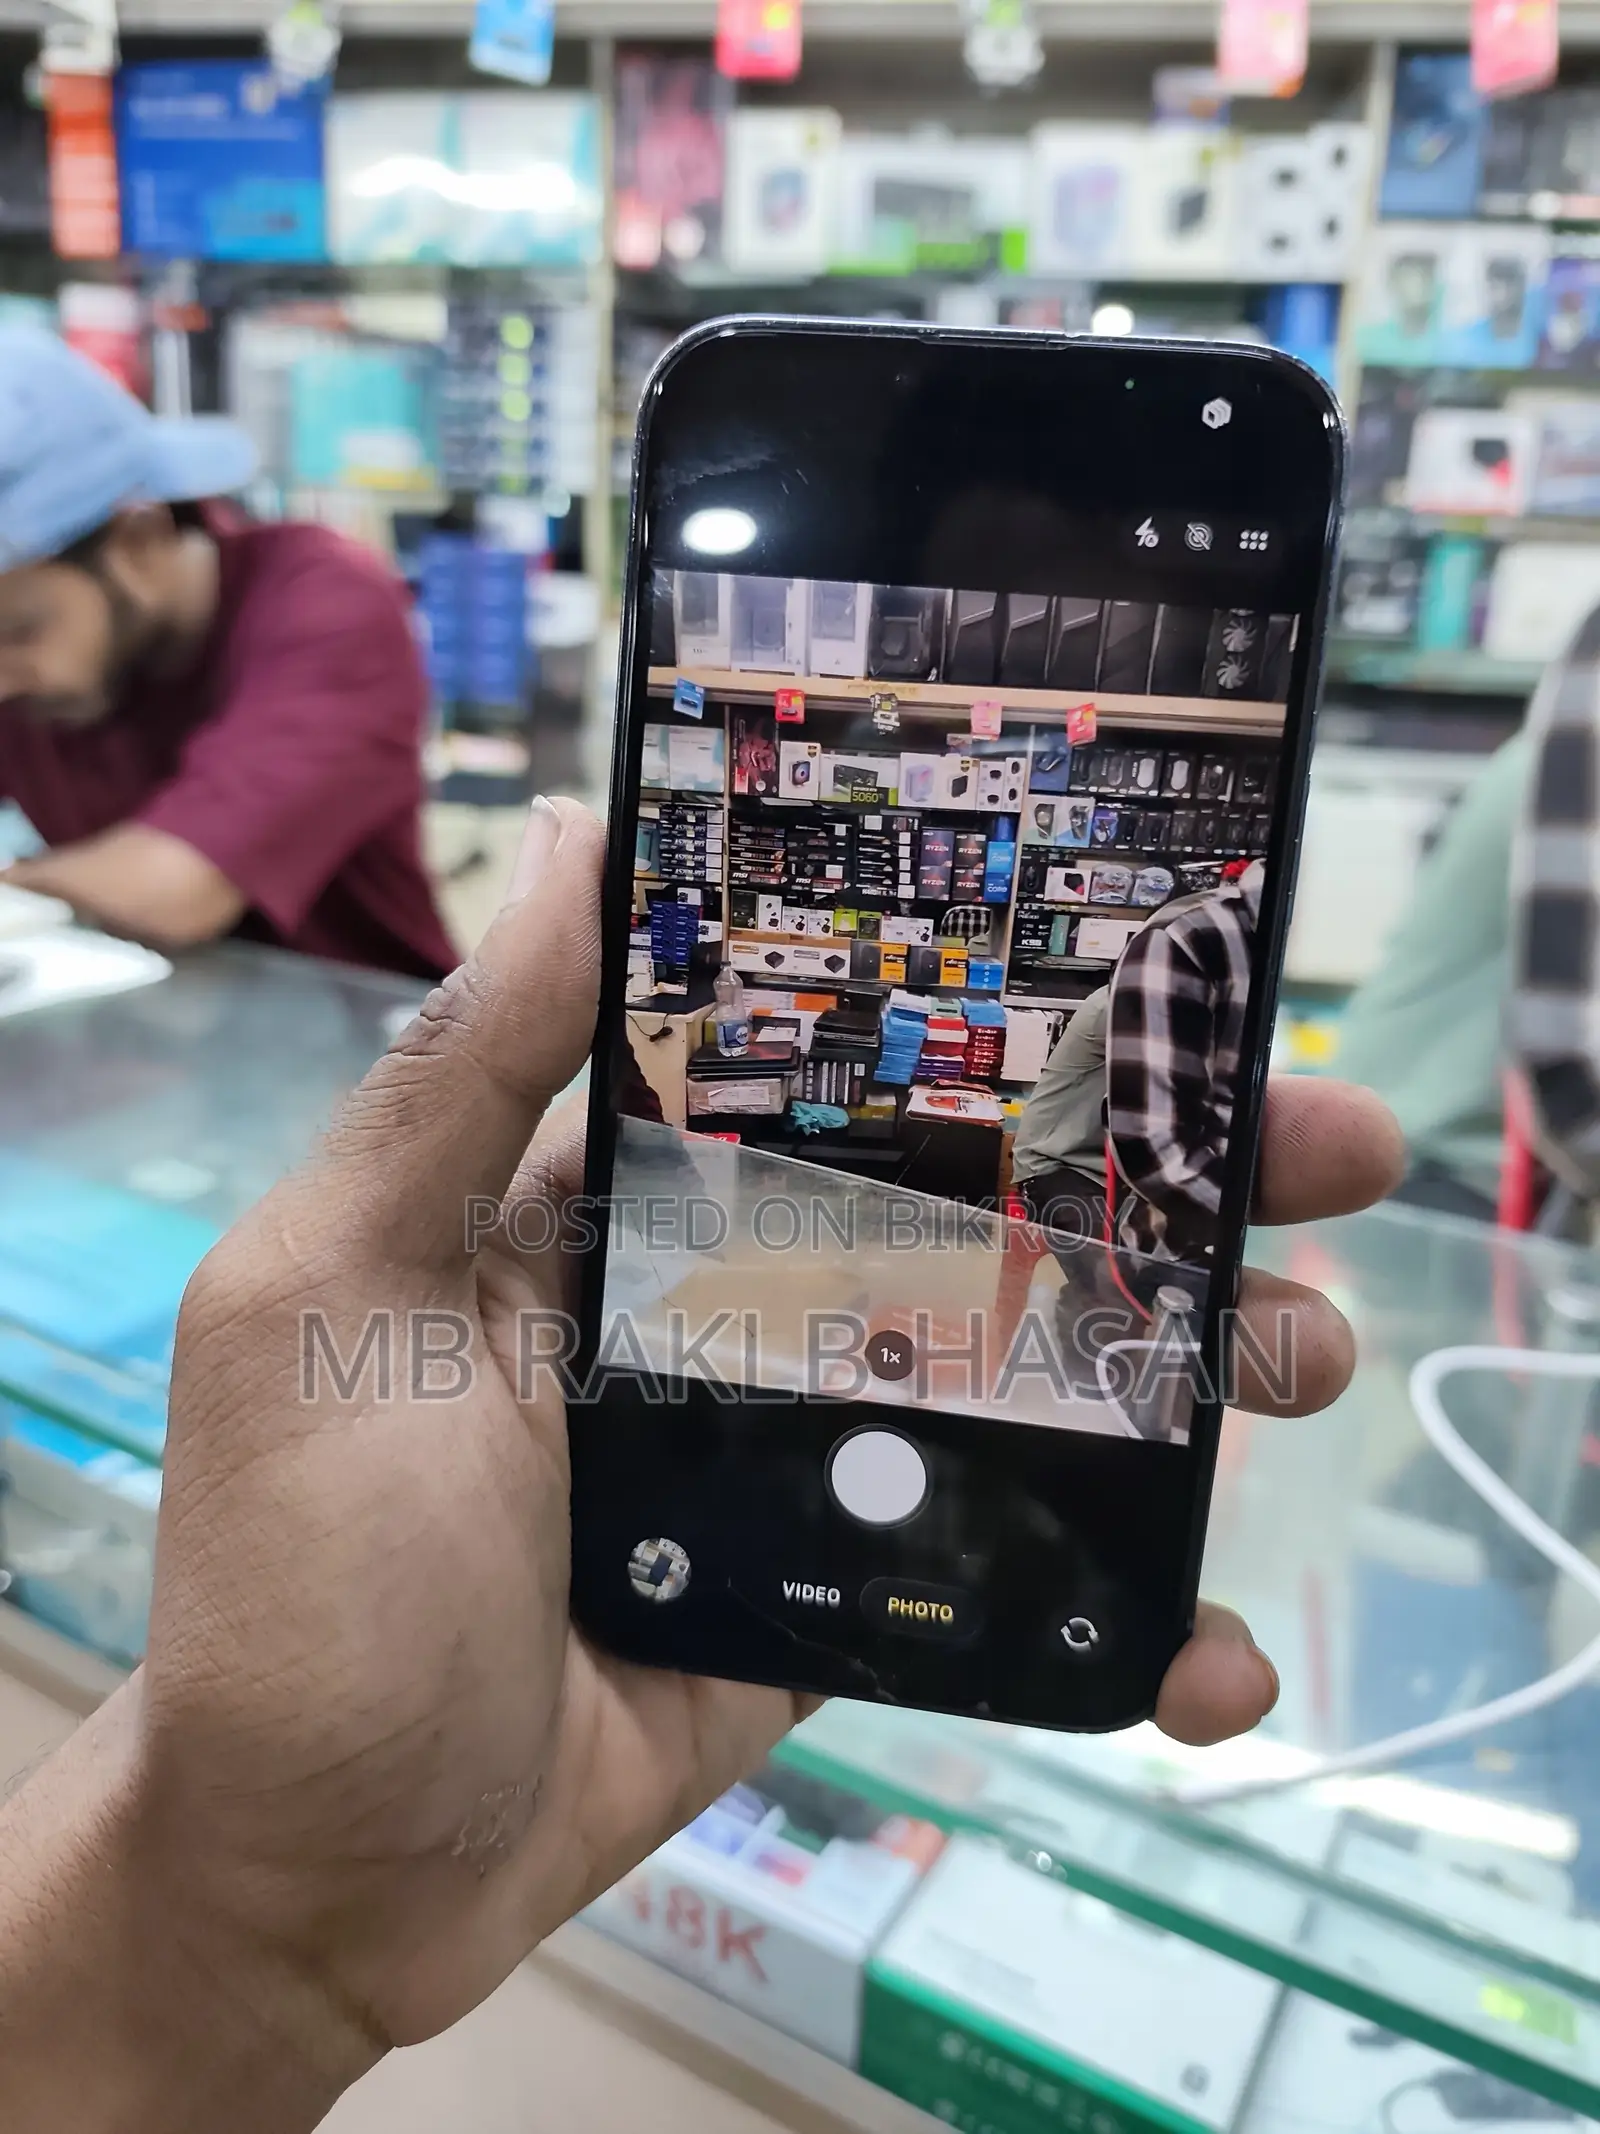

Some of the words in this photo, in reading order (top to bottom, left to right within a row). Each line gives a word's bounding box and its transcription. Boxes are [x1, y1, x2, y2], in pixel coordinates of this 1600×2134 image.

[852, 791, 879, 803] 5060
[925, 844, 949, 852] RYZEN
[958, 847, 982, 855] RYZEN
[922, 878, 946, 886] RYZEN
[956, 881, 980, 889] RYZEN
[879, 1345, 902, 1366] 1x
[782, 1580, 841, 1607] VIDEO
[888, 1596, 954, 1624] PHOTO
